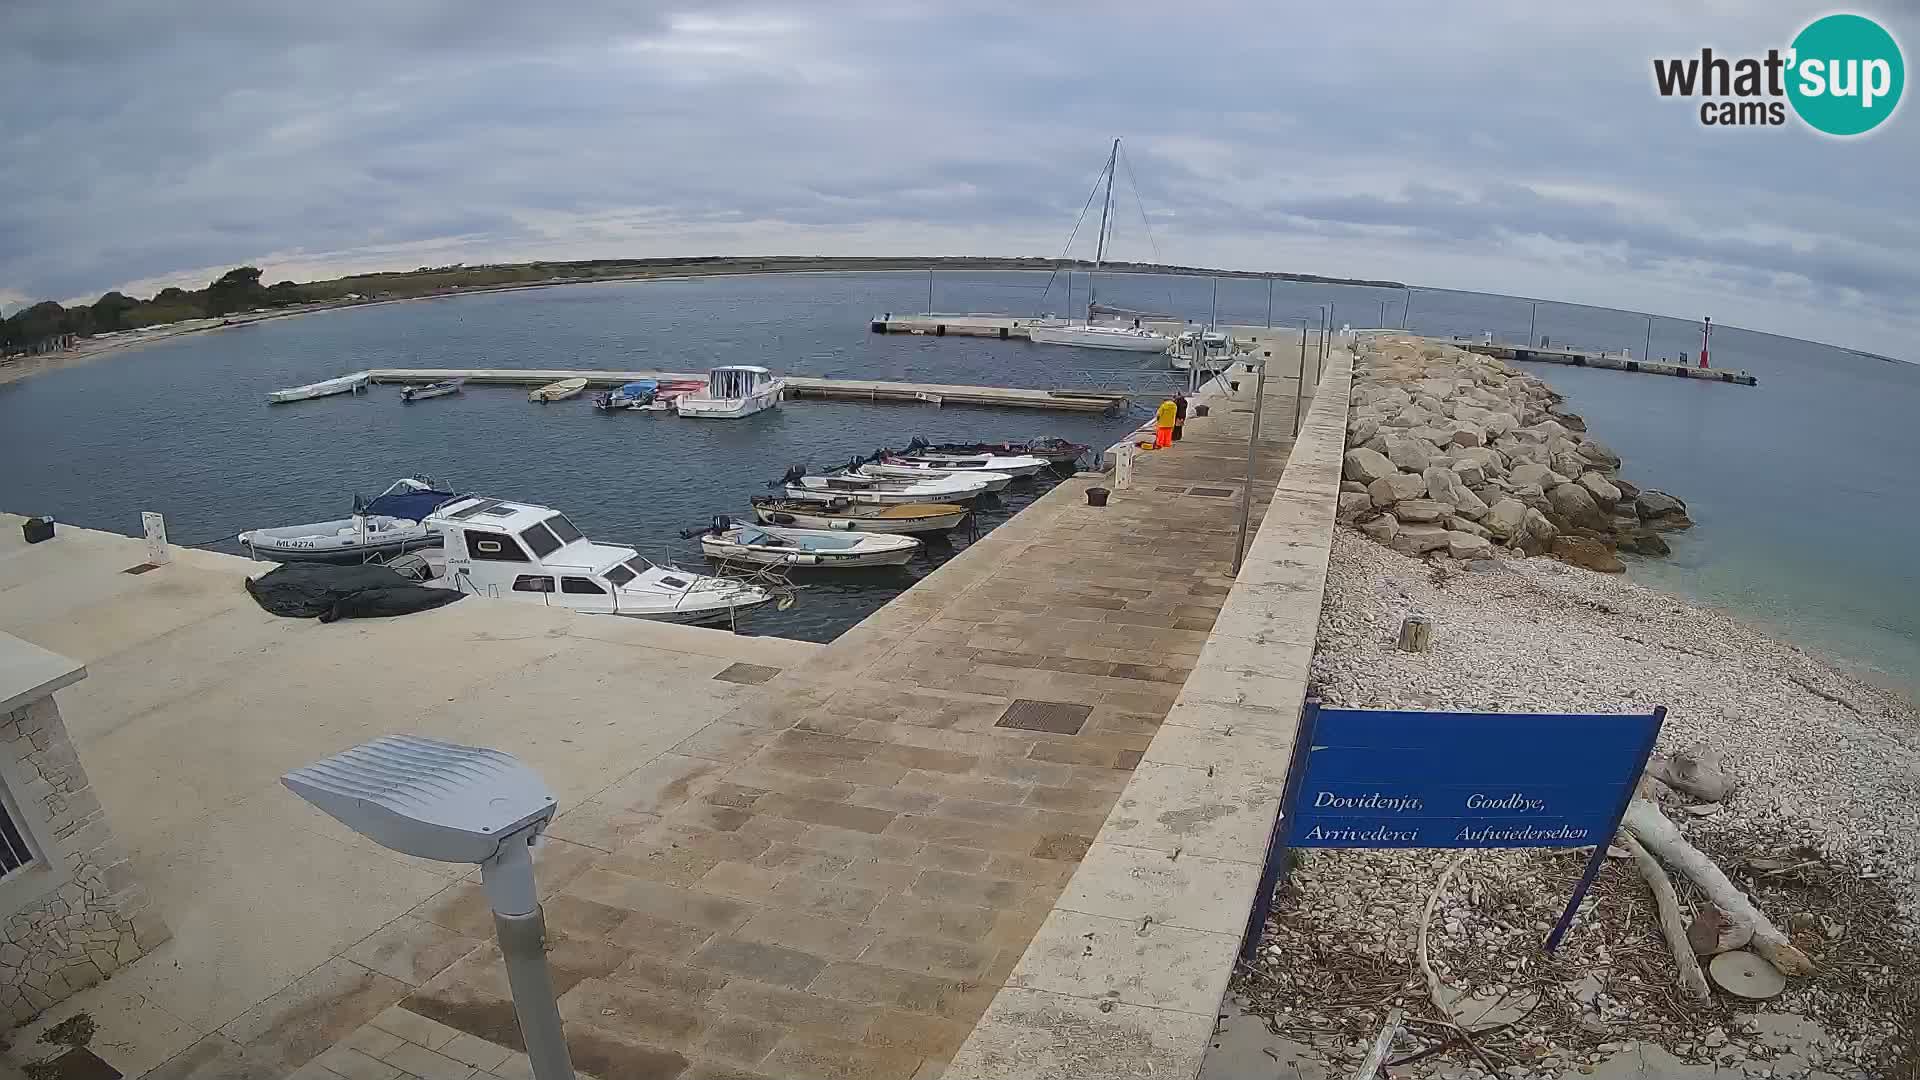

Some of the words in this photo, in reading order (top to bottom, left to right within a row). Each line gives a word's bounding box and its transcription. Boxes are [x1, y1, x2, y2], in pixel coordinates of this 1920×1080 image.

[1314, 791, 1424, 812] Doviđenja,
[1466, 792, 1546, 812] Goodbye,
[1305, 824, 1419, 841] Arrivederci
[1455, 824, 1589, 841] Aufwiedersehen
